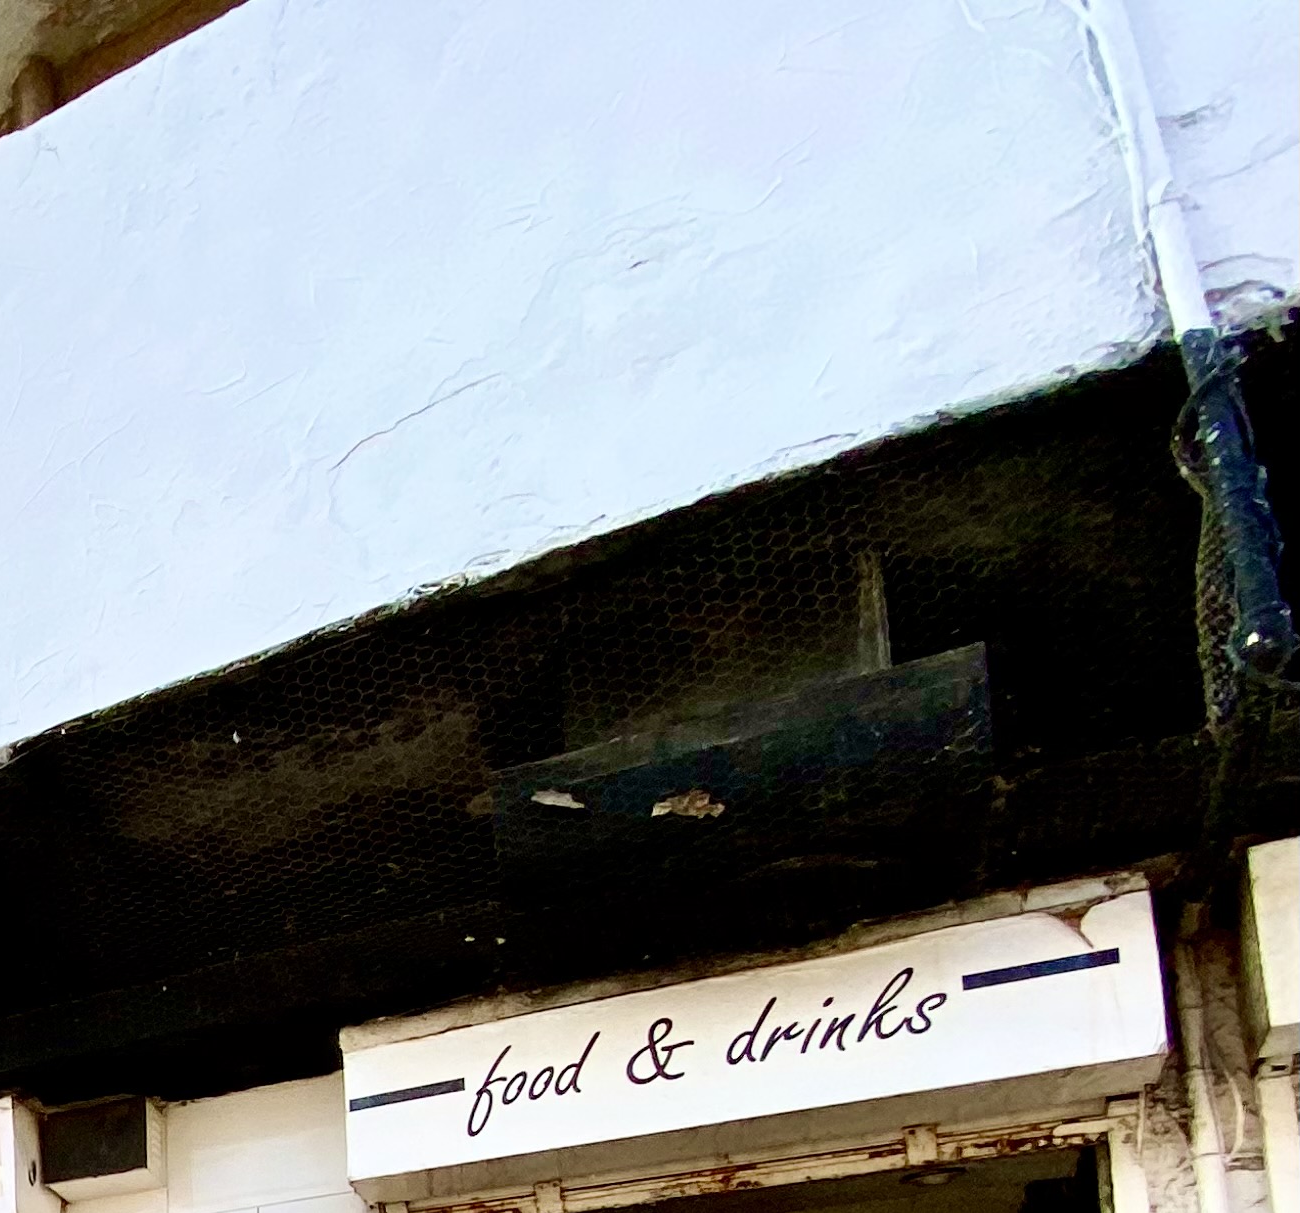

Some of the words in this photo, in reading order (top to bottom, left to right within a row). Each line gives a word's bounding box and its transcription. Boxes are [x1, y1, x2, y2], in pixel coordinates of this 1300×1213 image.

[467, 1031, 600, 1137] food
[627, 1018, 694, 1085] &
[726, 967, 947, 1067] drinks
